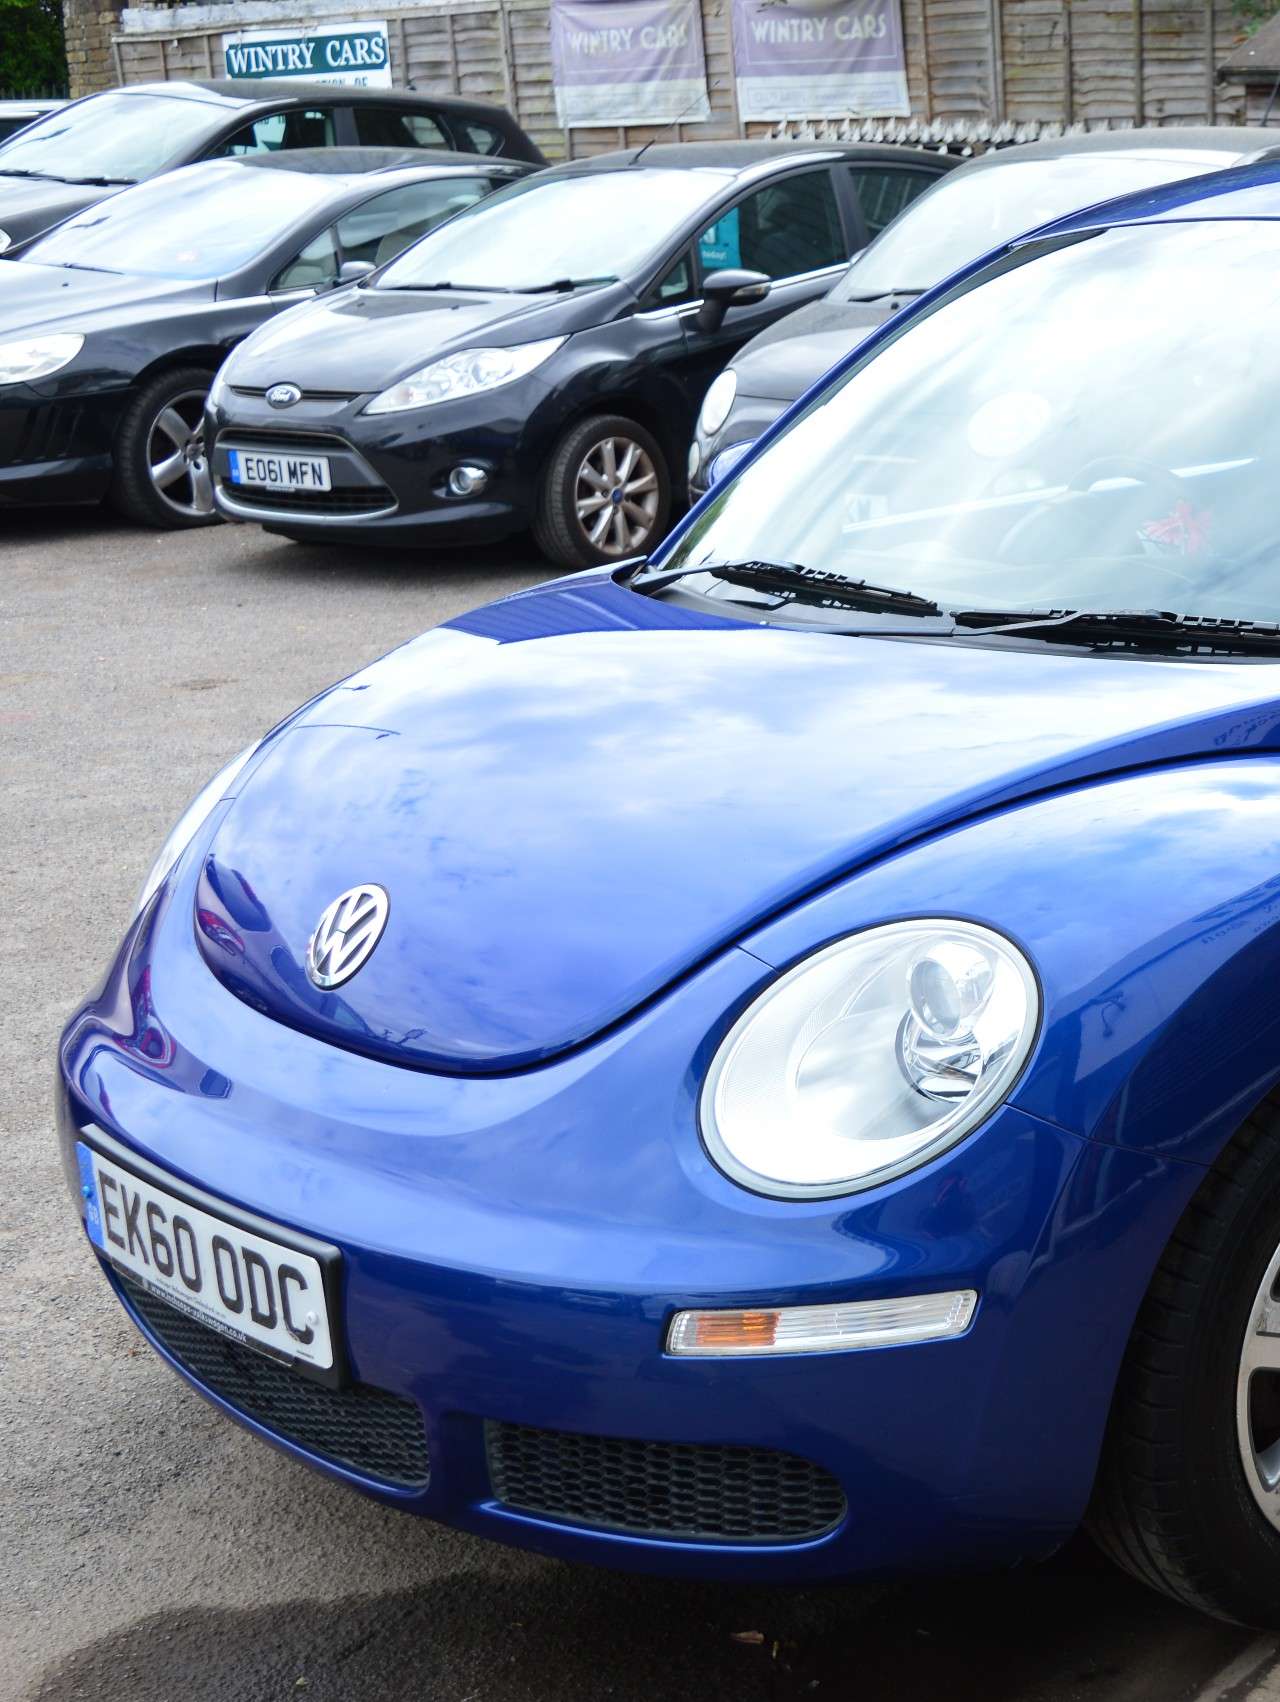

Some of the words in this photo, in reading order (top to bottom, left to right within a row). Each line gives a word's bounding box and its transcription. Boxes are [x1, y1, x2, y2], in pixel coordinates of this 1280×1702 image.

[570, 29, 633, 54] WINTRY
[641, 24, 688, 49] CARS
[751, 18, 828, 44] WINTRY
[834, 14, 887, 40] CARS
[229, 43, 315, 74] WINTRY
[326, 37, 385, 67] CARS
[287, 461, 324, 486] MFN
[97, 1169, 202, 1294] EK60
[212, 1234, 315, 1345] ODC
